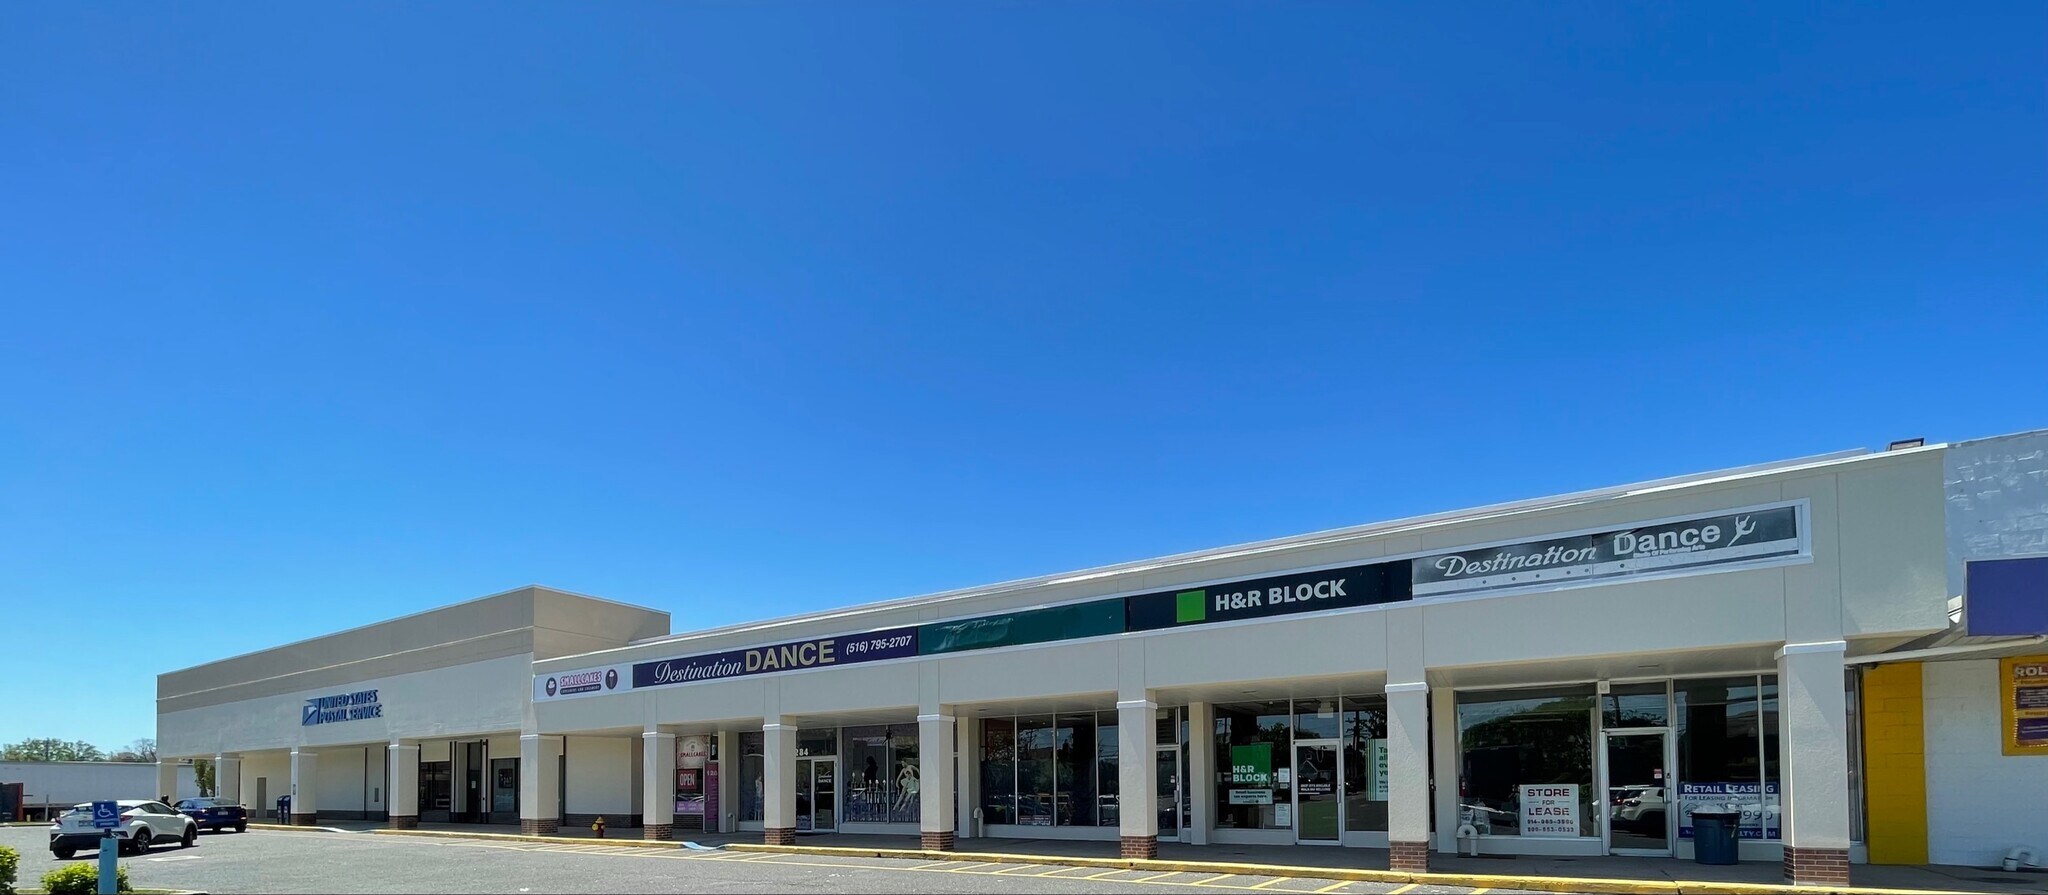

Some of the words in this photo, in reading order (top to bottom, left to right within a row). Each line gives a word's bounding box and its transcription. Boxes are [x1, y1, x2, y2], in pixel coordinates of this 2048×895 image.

[1435, 546, 1597, 577] Destination
[1613, 524, 1721, 556] Dance
[1215, 590, 1262, 611] H&R
[1268, 578, 1347, 605] BLOCK
[654, 657, 744, 684] Destination
[745, 640, 836, 672] DANCE
[846, 640, 868, 655] (516)
[870, 635, 912, 651] 795-2707
[560, 671, 602, 687] SMALLCAKES
[320, 695, 349, 709] UNITED
[350, 690, 378, 705] STATES
[320, 708, 349, 724] POSTAL
[350, 704, 382, 721] SERVICE
[1232, 765, 1255, 773] H&R
[680, 773, 695, 786] OPEN
[1232, 773, 1268, 782] BLOCK
[1527, 788, 1570, 797] STORE
[1684, 784, 1723, 793] RETAIL
[1528, 807, 1570, 816] LEASE
